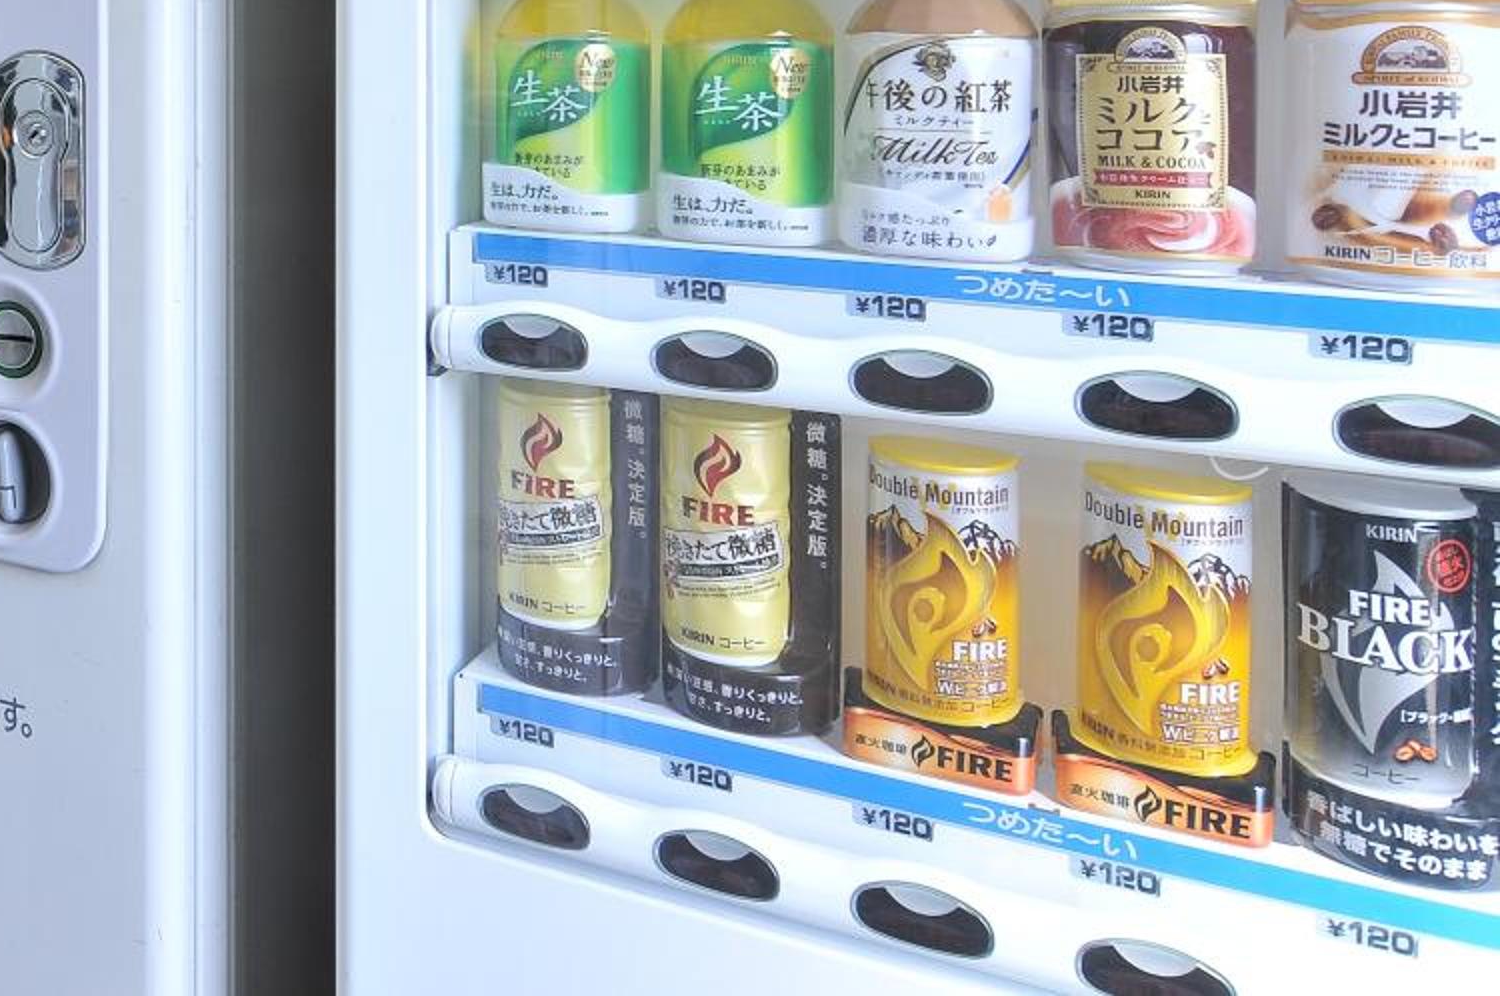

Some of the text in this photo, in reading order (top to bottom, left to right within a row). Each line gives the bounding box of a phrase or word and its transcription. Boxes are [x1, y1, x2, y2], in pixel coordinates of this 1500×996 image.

[510, 69, 588, 123] 生茶
[1117, 75, 1185, 94] 小岩井
[694, 75, 785, 132] 生茶
[1359, 90, 1462, 120] 小岩井
[1096, 128, 1203, 151] ココア
[1323, 122, 1496, 151] ミルクとコーヒー
[1097, 155, 1136, 168] MILK
[1141, 156, 1152, 168] &
[1135, 188, 1171, 200] KIRIN
[1325, 245, 1371, 259] KIRIN
[493, 264, 548, 286] ¥120
[663, 279, 725, 302] ¥120
[856, 295, 925, 320] ¥120
[1073, 313, 1153, 340] ¥120
[1321, 335, 1411, 364] ¥120
[511, 470, 575, 499] FIRE
[869, 463, 1010, 508] Double Mountain
[682, 494, 755, 526] FIRE
[1085, 490, 1244, 541] Double Mountain
[1365, 523, 1419, 543] KIRIN
[1349, 589, 1432, 628] FIRE
[953, 639, 1008, 662] FIRE
[1297, 601, 1475, 675] BLACK
[1180, 683, 1241, 705] FIRE
[498, 718, 553, 748] ¥120
[667, 760, 733, 792] ¥120
[937, 745, 1013, 784] FIRE
[1351, 763, 1420, 784] コーヒー
[863, 805, 933, 842] ¥120
[1165, 798, 1253, 840] FIRE
[1320, 820, 1489, 881] 無糖でそのまま
[1080, 858, 1159, 895] ¥120
[1327, 917, 1418, 957] ¥120
